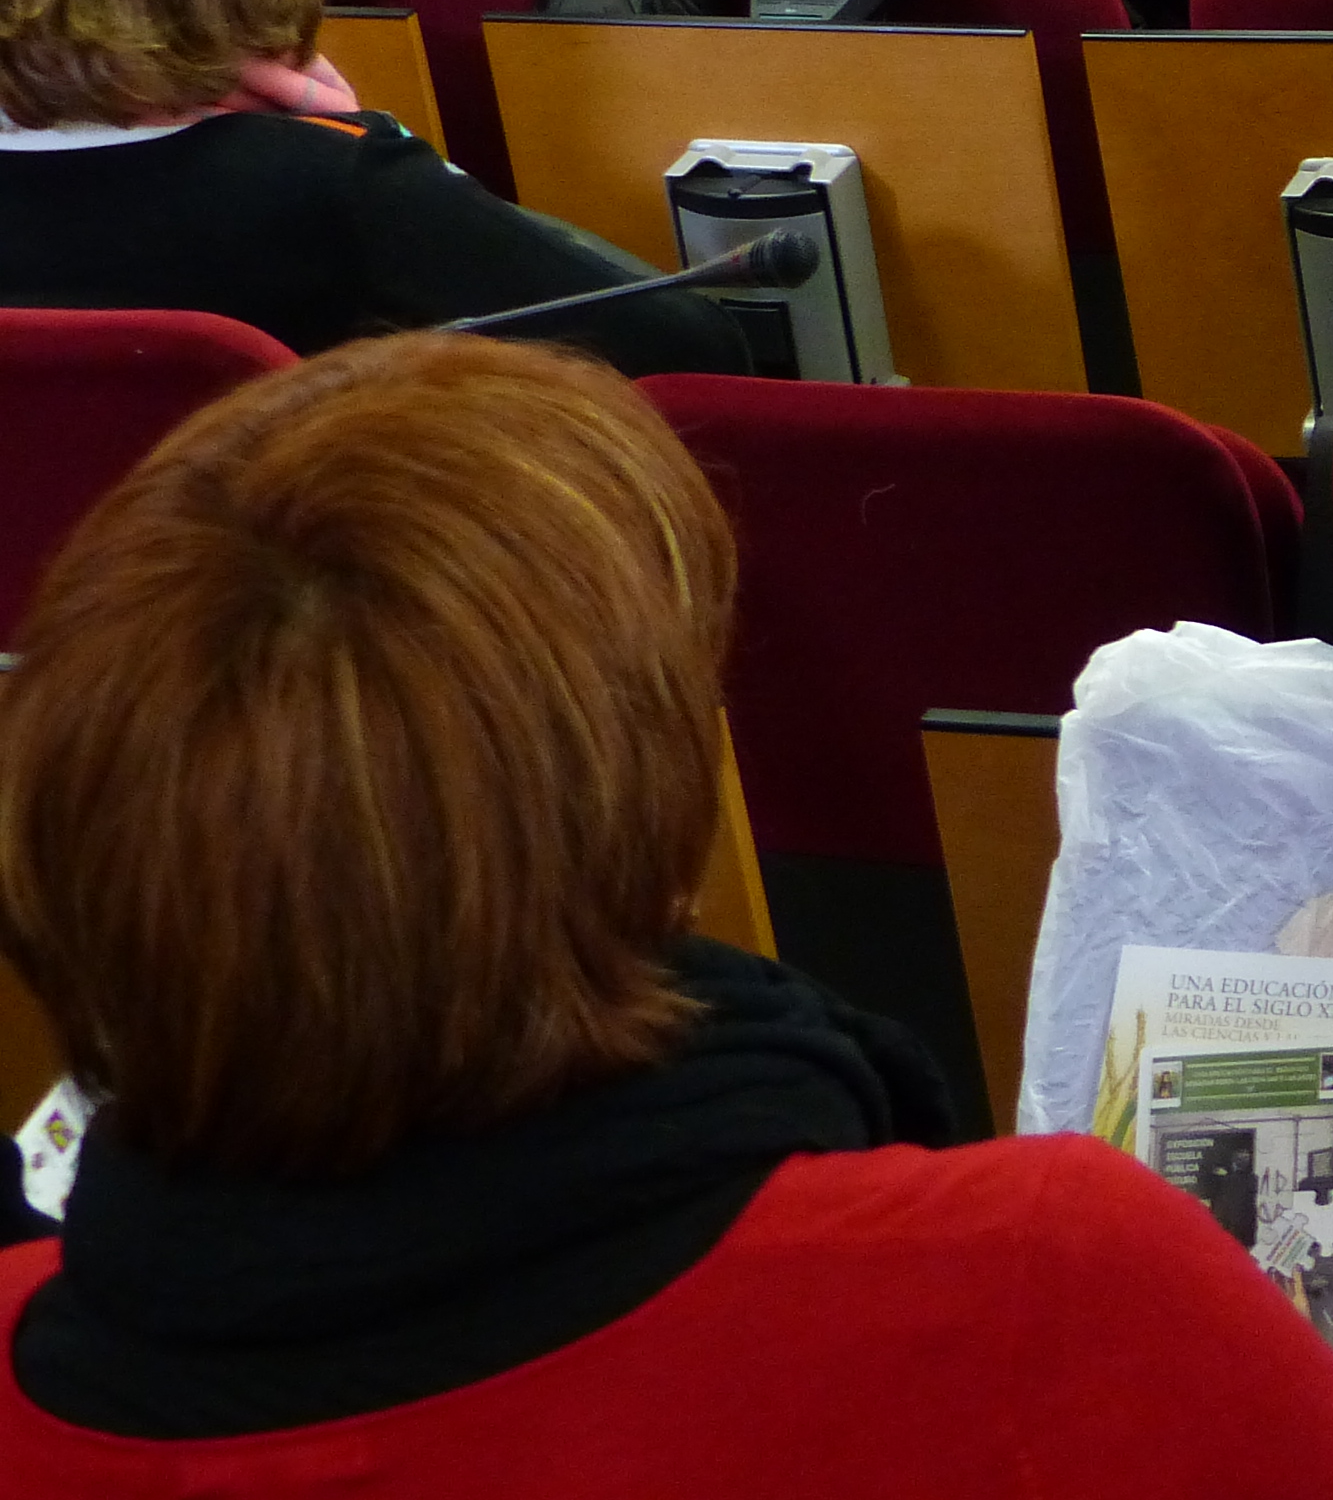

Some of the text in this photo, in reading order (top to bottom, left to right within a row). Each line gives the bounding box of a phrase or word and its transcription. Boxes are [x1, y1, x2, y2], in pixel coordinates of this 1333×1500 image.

[1171, 974, 1214, 992] UNA
[1167, 992, 1217, 1012] PARA
[1224, 995, 1246, 1013] EL
[1252, 999, 1313, 1018] SIGLO
[1161, 1025, 1189, 1037] LAS
[1165, 1012, 1280, 1032] MIRADAS DESDE
